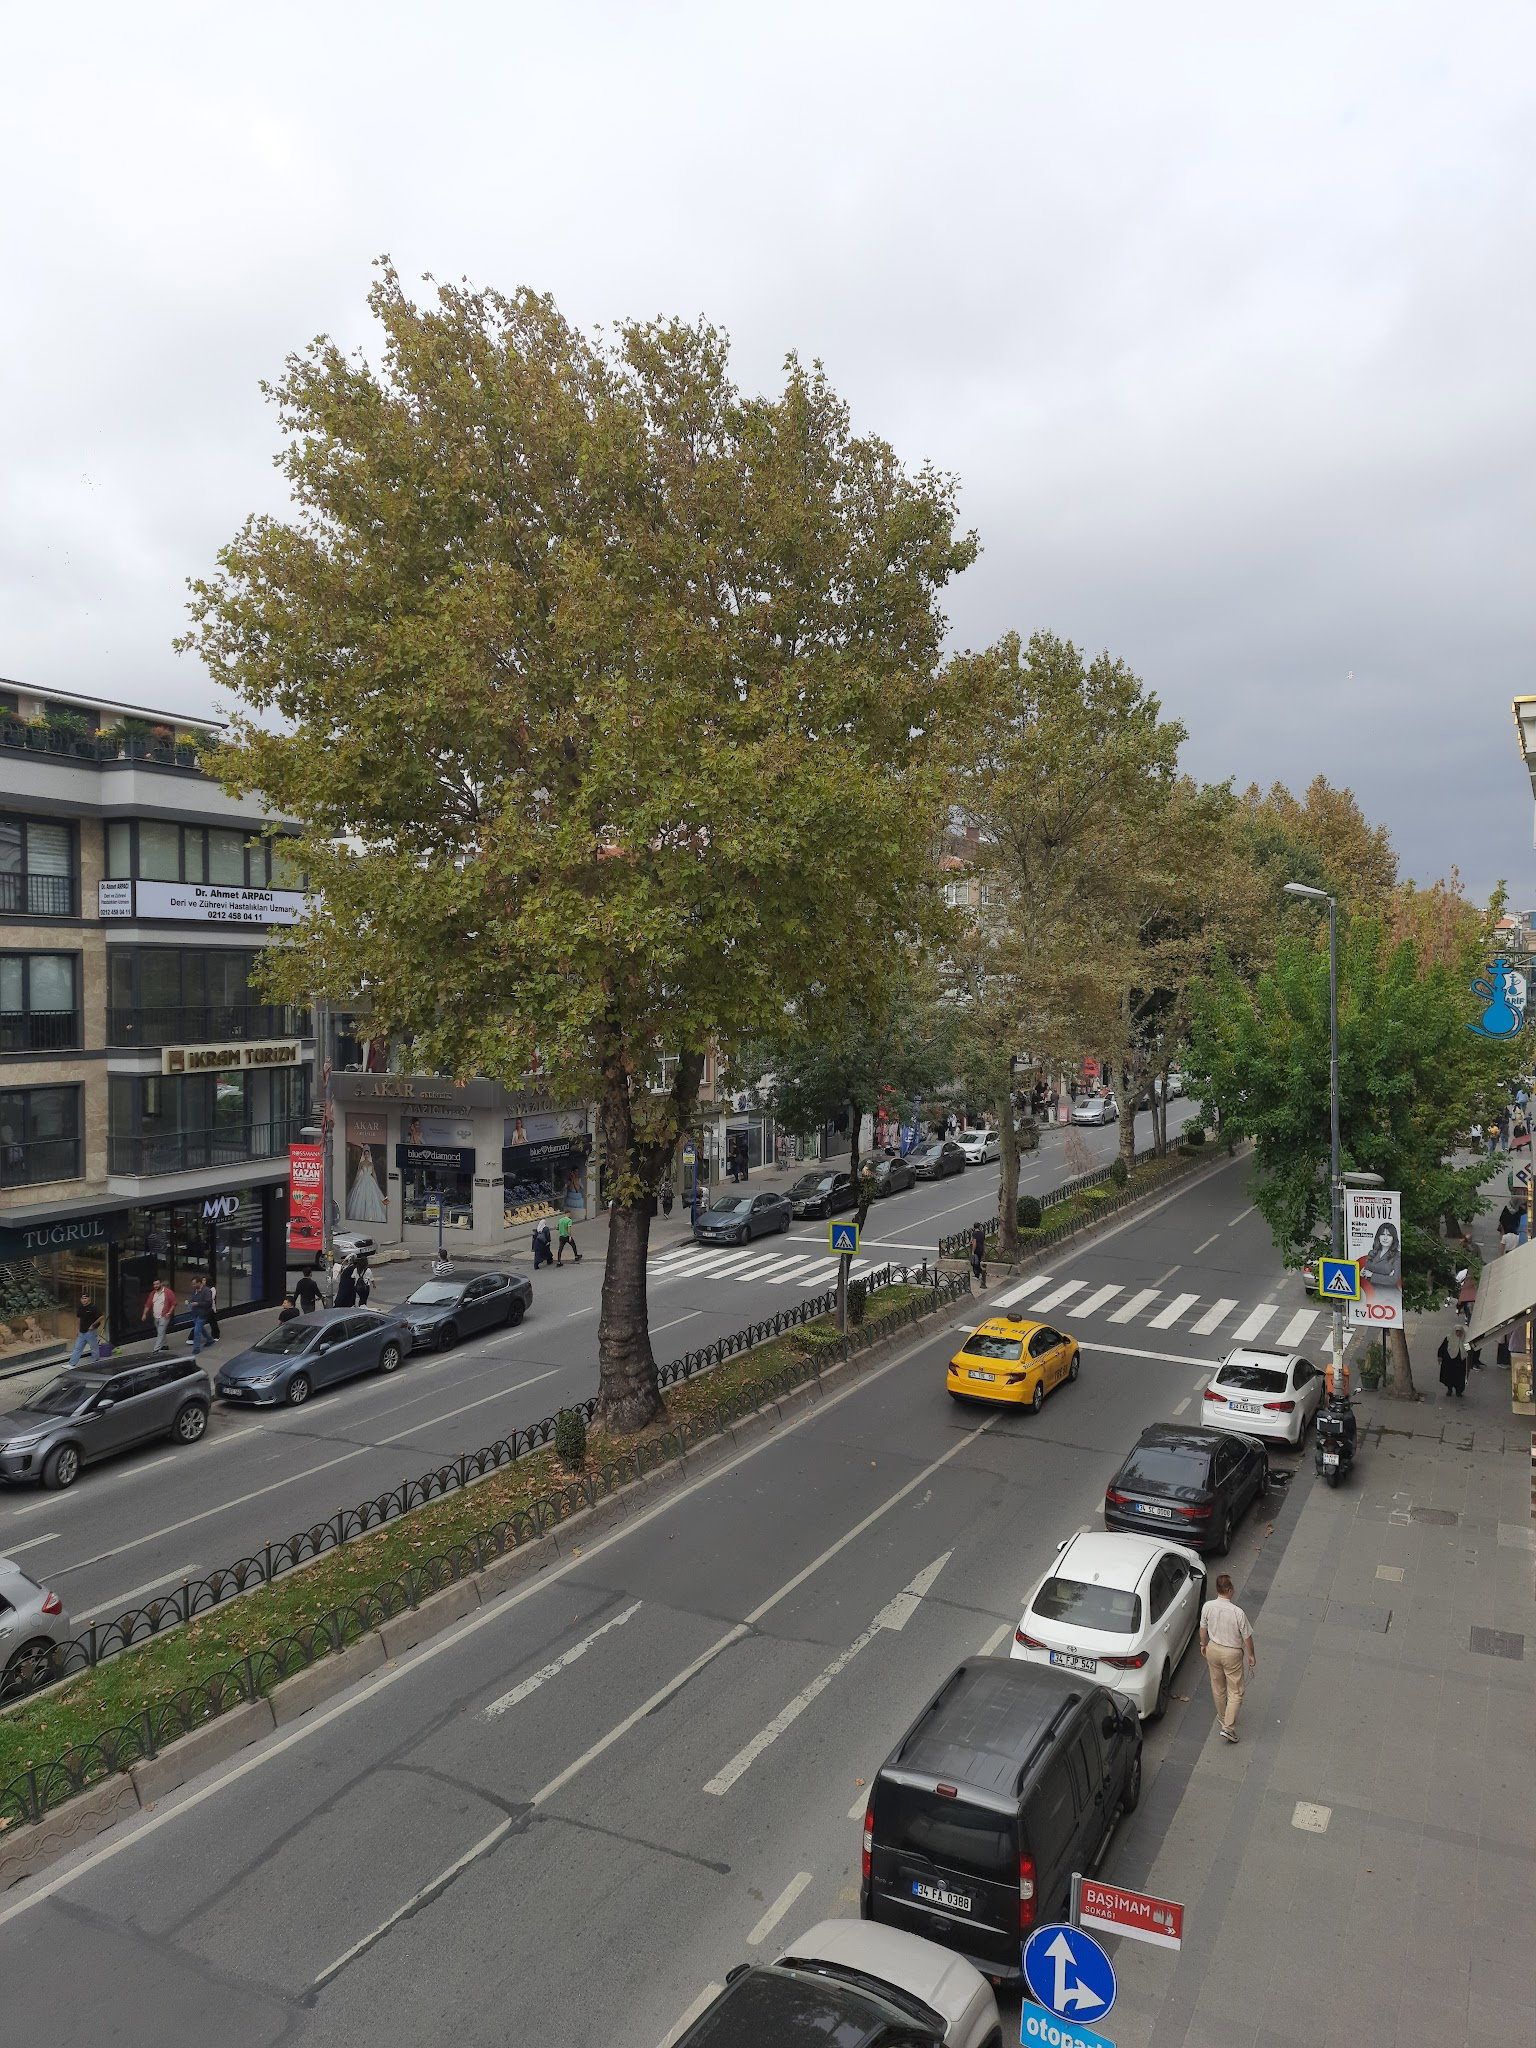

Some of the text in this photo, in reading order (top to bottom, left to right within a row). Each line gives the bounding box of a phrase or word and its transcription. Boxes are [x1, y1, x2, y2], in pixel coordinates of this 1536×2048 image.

[195, 888, 273, 901] Dr. Ahmet ARPACI
[170, 898, 187, 907] Deri
[199, 900, 228, 909] Zührevi
[208, 911, 226, 919] 0212
[243, 912, 252, 920] 04
[353, 1121, 379, 1131] AKAR
[407, 1149, 461, 1161] blue diamond
[529, 1146, 541, 1157] blue
[292, 1161, 306, 1169] KAT
[292, 1168, 320, 1178] KAZAN
[1354, 1203, 1392, 1220] ÖNCÜ YÜZ
[23, 1221, 105, 1249] TUĞRUL
[1055, 1653, 1094, 1669] 34 FJP 542
[918, 1884, 969, 1909] 34 FA 0388
[1087, 1889, 1151, 1917] BAŞİMAM
[1084, 1905, 1116, 1920] SOKAĞI
